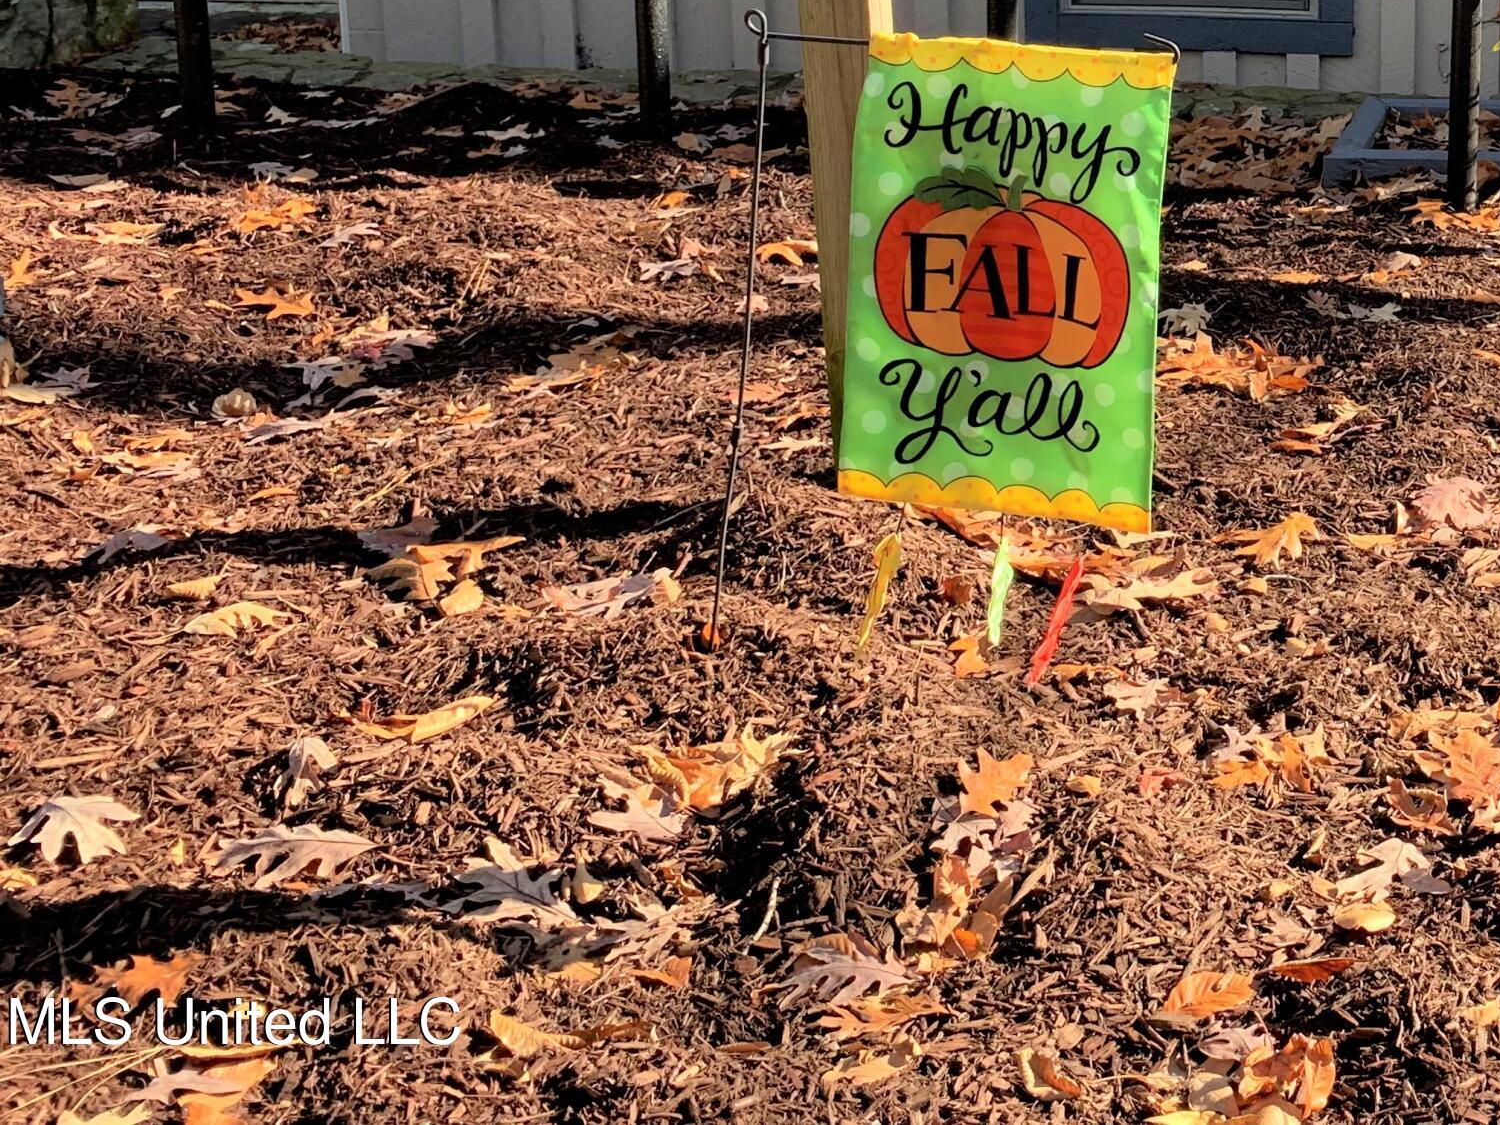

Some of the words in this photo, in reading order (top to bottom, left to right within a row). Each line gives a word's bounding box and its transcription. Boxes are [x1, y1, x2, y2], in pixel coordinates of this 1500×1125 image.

[884, 81, 1140, 204] Happy
[901, 231, 1102, 331] FALL
[878, 358, 1100, 464] Y'all
